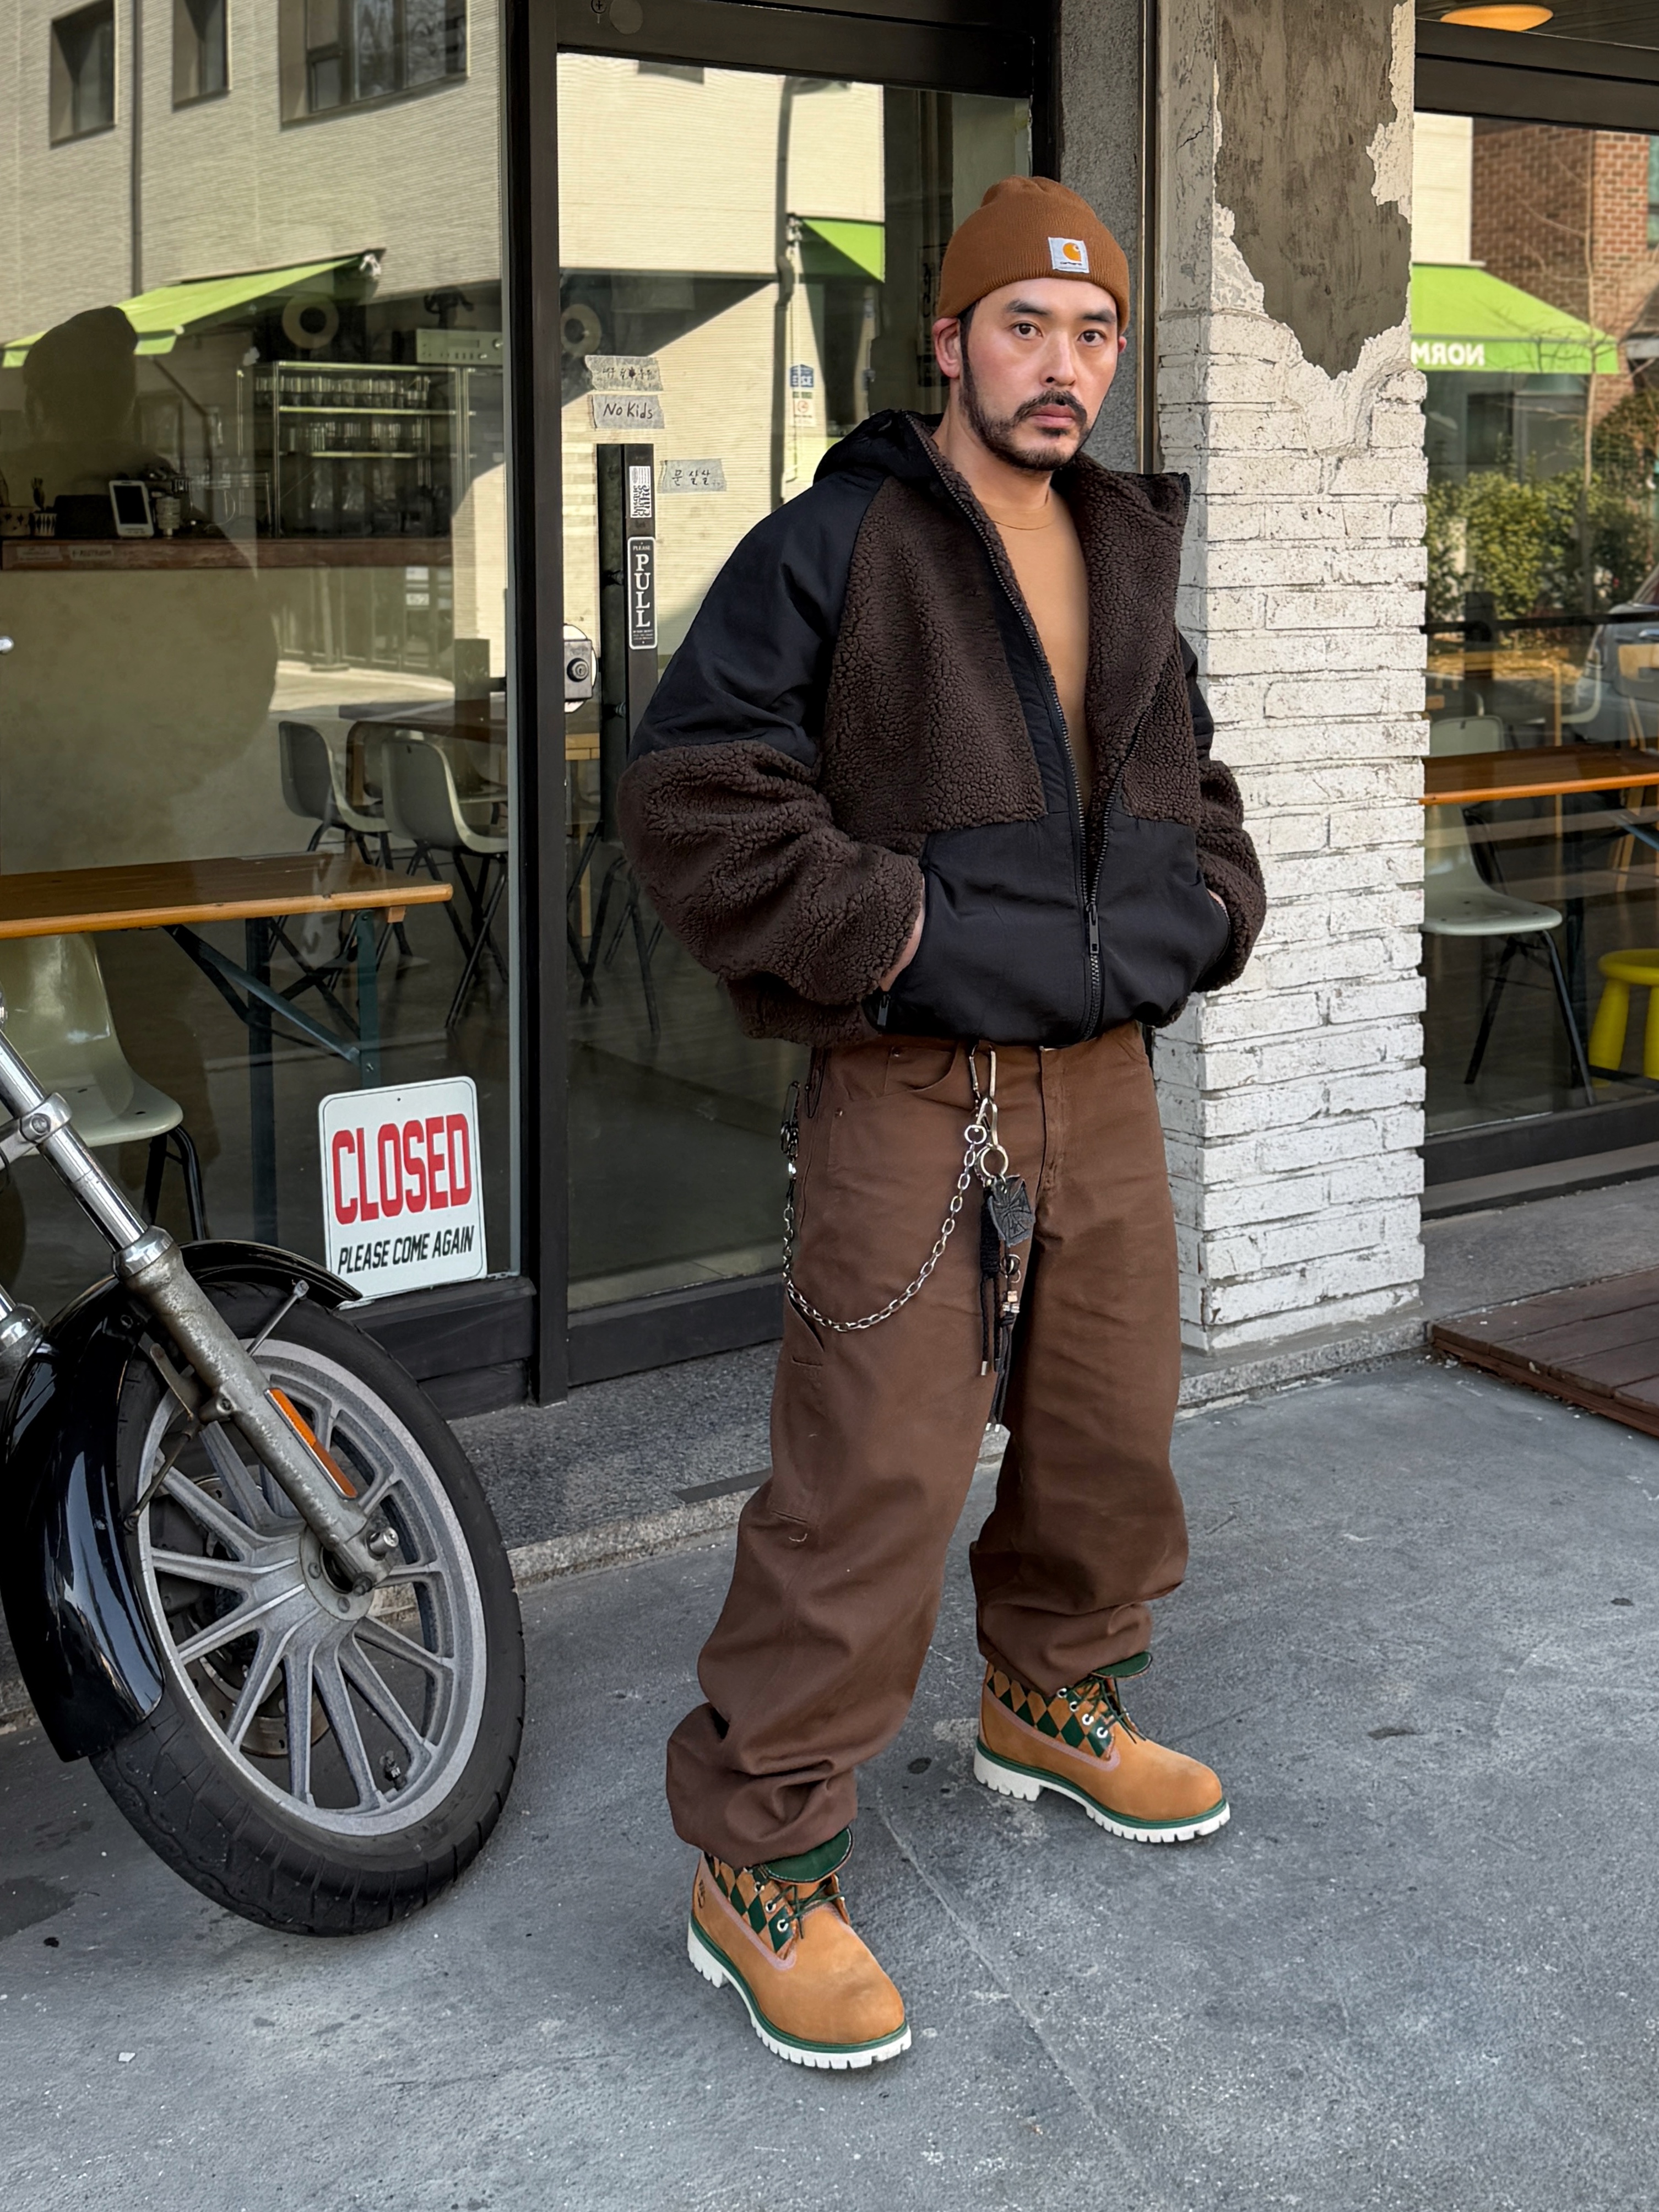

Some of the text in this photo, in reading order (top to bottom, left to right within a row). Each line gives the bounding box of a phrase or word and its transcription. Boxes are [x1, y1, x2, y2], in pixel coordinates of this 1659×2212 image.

[603, 401, 653, 419] No Kids
[671, 469, 683, 486] 문
[634, 554, 651, 628] PULL
[332, 1113, 472, 1225] CLOSED
[338, 1225, 475, 1275] PLEASE COME AGAIN
